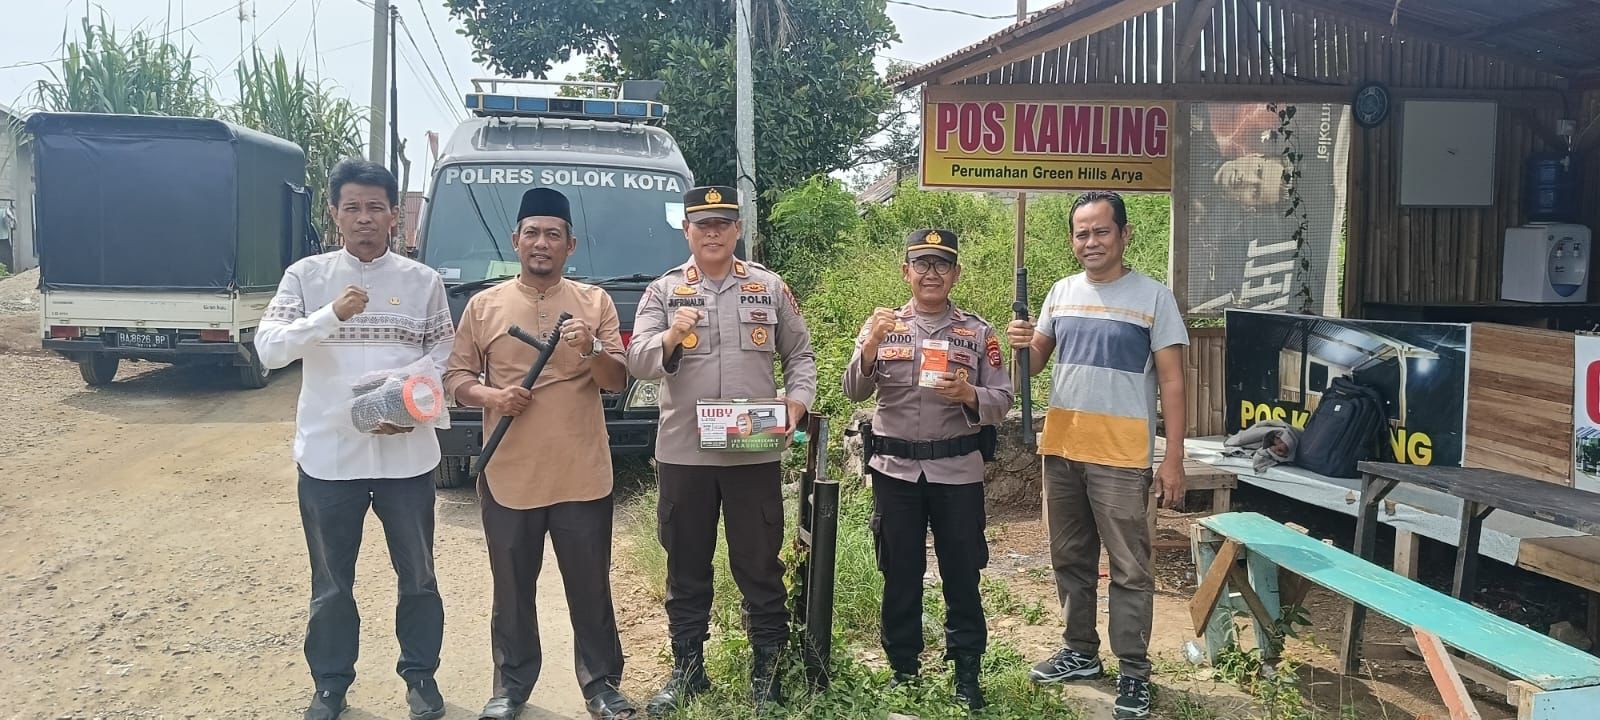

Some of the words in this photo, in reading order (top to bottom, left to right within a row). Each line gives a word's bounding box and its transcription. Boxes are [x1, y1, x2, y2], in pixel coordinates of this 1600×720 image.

[935, 102, 1006, 154] POS
[1013, 103, 1169, 157] KAMLING
[445, 168, 534, 185] POLRES
[540, 169, 616, 188] SOLOK
[623, 173, 681, 193] KOTA
[951, 164, 1028, 179] Perumahan
[1032, 165, 1073, 180] Green
[1078, 166, 1107, 181] Hills
[1111, 167, 1143, 184] Arya
[740, 295, 772, 305] POLRI
[119, 332, 130, 343] BA
[131, 334, 151, 344] 8626
[155, 335, 166, 345] BP
[947, 336, 978, 352] POLRI
[701, 408, 733, 418] LUBY
